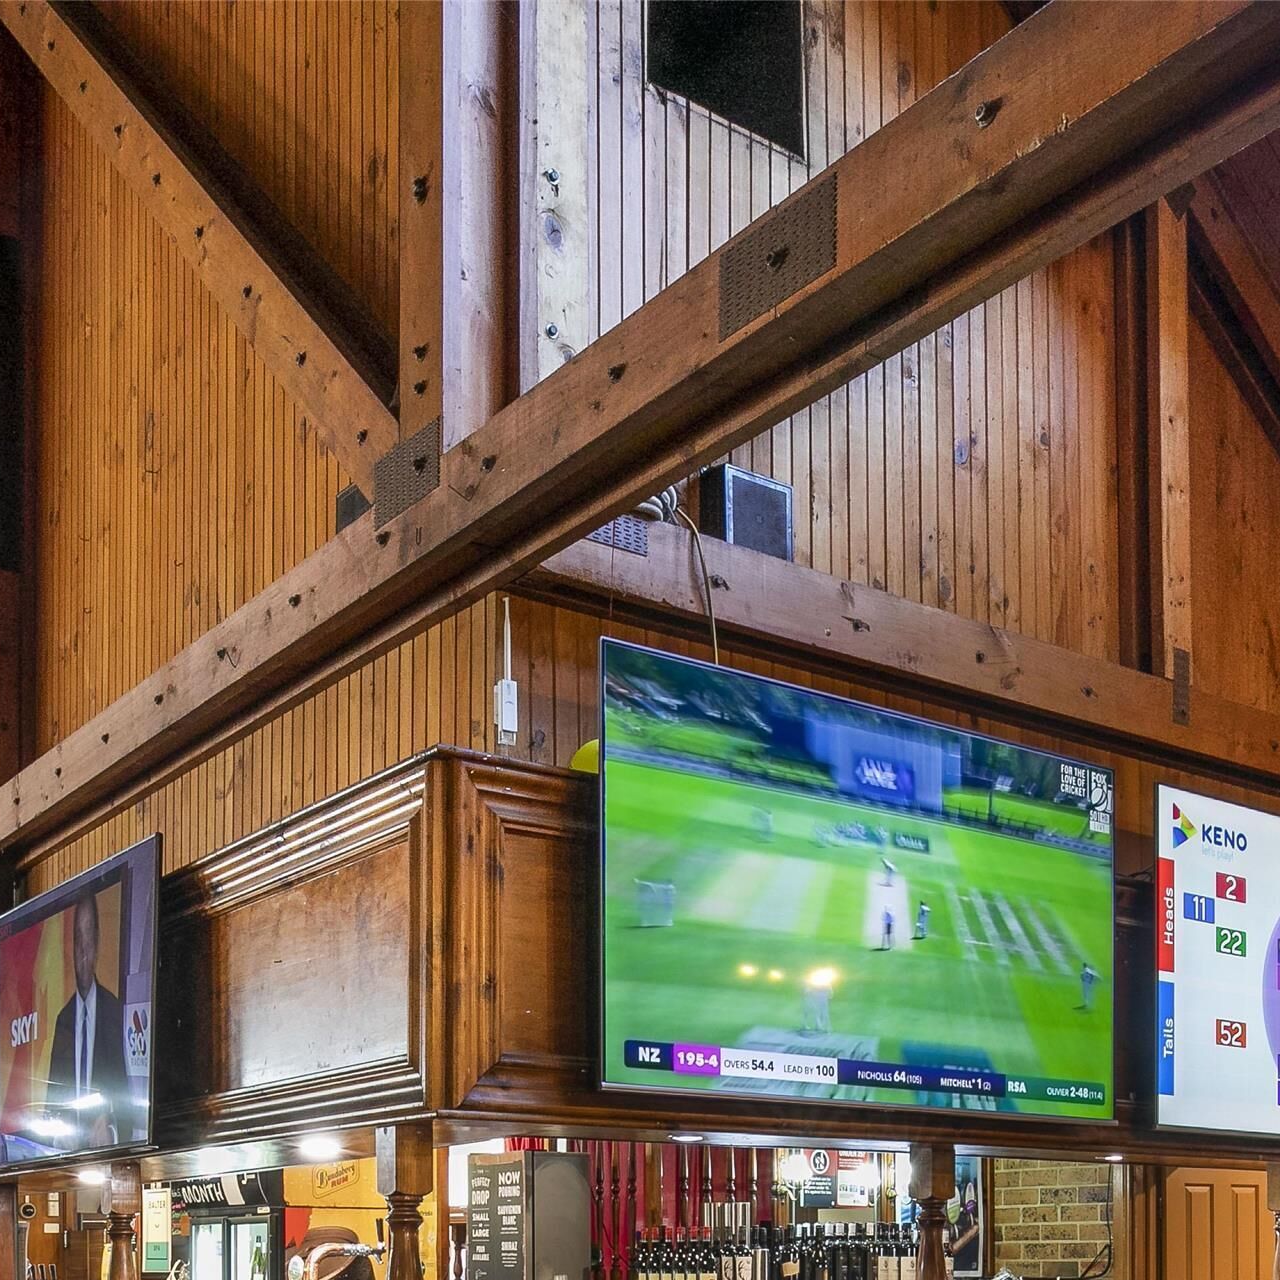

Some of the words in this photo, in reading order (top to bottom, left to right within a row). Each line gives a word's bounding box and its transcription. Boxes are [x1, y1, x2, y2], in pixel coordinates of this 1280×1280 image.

[1061, 764, 1072, 774] FOR
[1074, 767, 1086, 778] THE
[1091, 771, 1107, 785] FOX
[1061, 774, 1076, 785] LOVE
[1077, 778, 1086, 787] OF
[1060, 784, 1086, 798] CRICKET
[1201, 823, 1248, 852] KENO
[1225, 876, 1237, 900] 2
[1193, 896, 1207, 921] 11
[1163, 887, 1174, 945] Heads
[1220, 930, 1242, 955] 22
[11, 1011, 38, 1047] SKY1
[1220, 1022, 1242, 1047] 52
[1163, 1017, 1174, 1058] Tails
[638, 1046, 660, 1063] NZ
[677, 1051, 719, 1067] 195-4
[724, 1059, 750, 1070] OVERS
[751, 1059, 775, 1072] 54.4
[783, 1064, 803, 1075] LEAD
[804, 1066, 814, 1076] BY
[815, 1064, 835, 1077] 100
[857, 1070, 893, 1082] NICHOLLS
[893, 1071, 906, 1083] 64
[976, 1078, 983, 1090] 1
[983, 1081, 991, 1091] (2)
[1007, 1081, 1027, 1094] RSA
[1046, 1086, 1070, 1097] OLIVIER
[1070, 1086, 1089, 1098] 2-48
[331, 1174, 349, 1188] RUM
[472, 1177, 491, 1188] PERFECT
[498, 1171, 521, 1185] NOW
[182, 1182, 224, 1204] MONTH
[472, 1190, 490, 1205] DROP
[498, 1185, 521, 1198] POURING
[472, 1213, 490, 1221] SMALL
[502, 1215, 517, 1225] BLANC
[472, 1229, 490, 1238] LARGE
[501, 1241, 518, 1251] SHIRAZ
